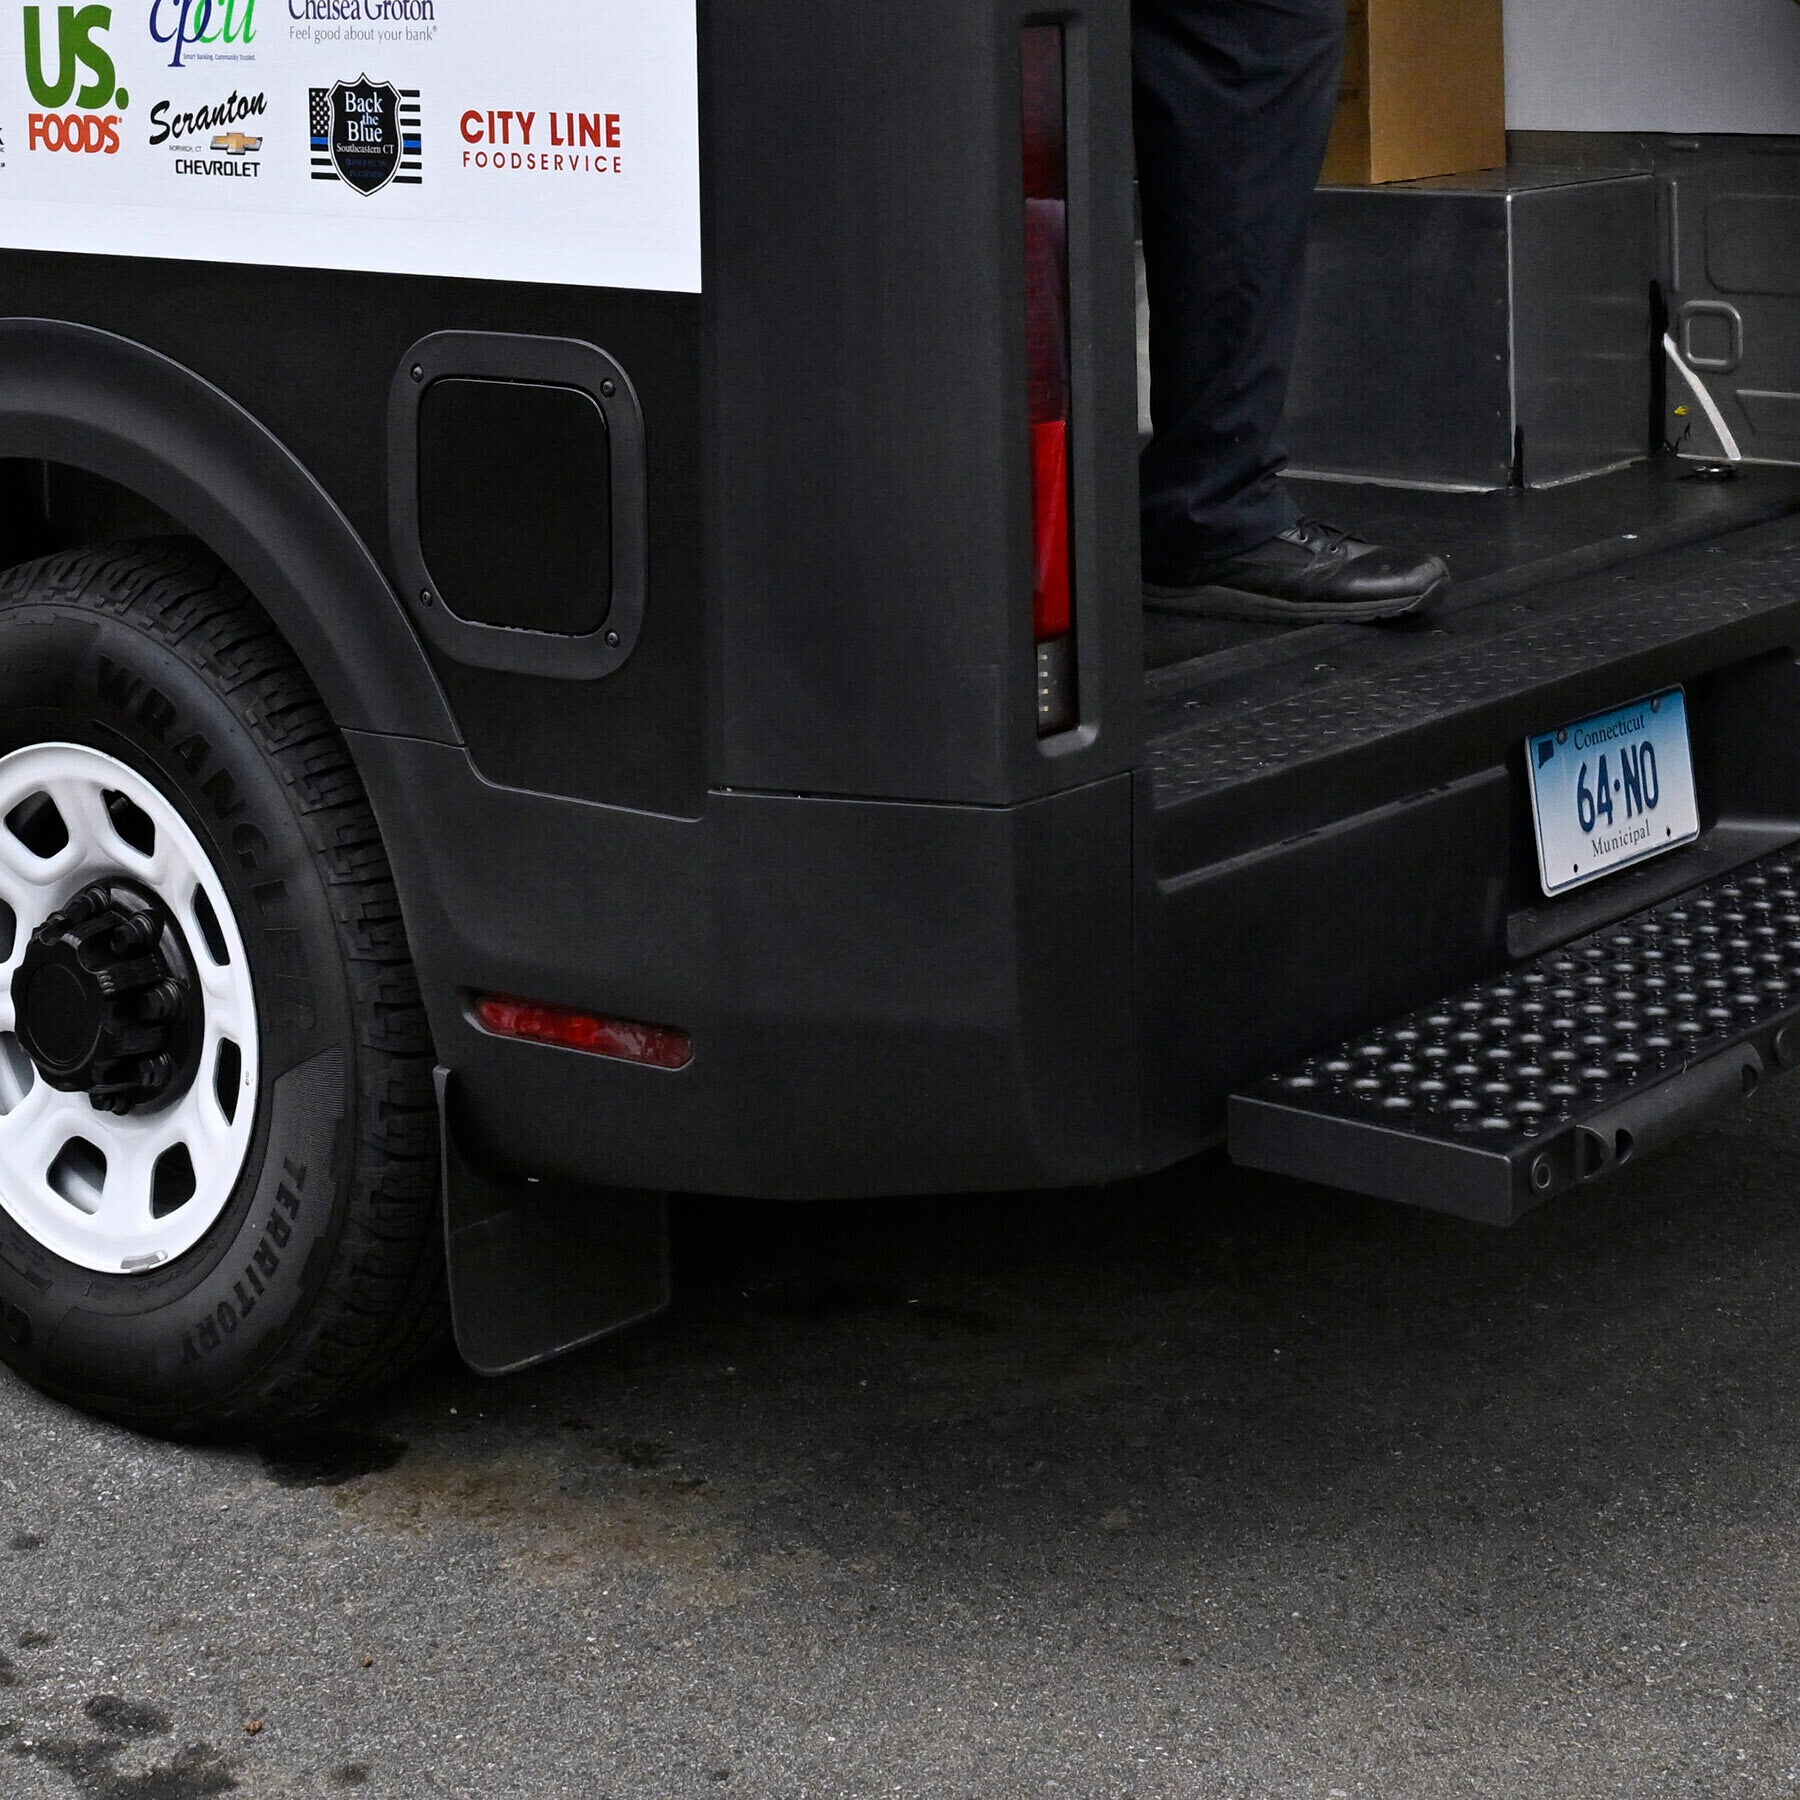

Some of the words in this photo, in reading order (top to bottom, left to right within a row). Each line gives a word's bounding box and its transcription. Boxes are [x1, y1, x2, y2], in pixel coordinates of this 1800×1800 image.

[289, 25, 311, 41] Feel
[313, 25, 341, 45] good
[344, 25, 376, 41] about
[378, 29, 403, 45] your
[344, 91, 384, 114] Back
[149, 89, 268, 146] Scranton
[361, 111, 380, 126] the
[460, 109, 537, 146] CITY
[549, 112, 622, 148] LINE
[346, 120, 383, 143] Blue
[382, 144, 395, 155] CT
[175, 158, 261, 178] CHEVROLET
[462, 151, 623, 174] FOODSERVICE
[1574, 714, 1645, 750] Connecticut
[1591, 818, 1651, 859] Municipal
[180, 1156, 308, 1363] TERRITORY
